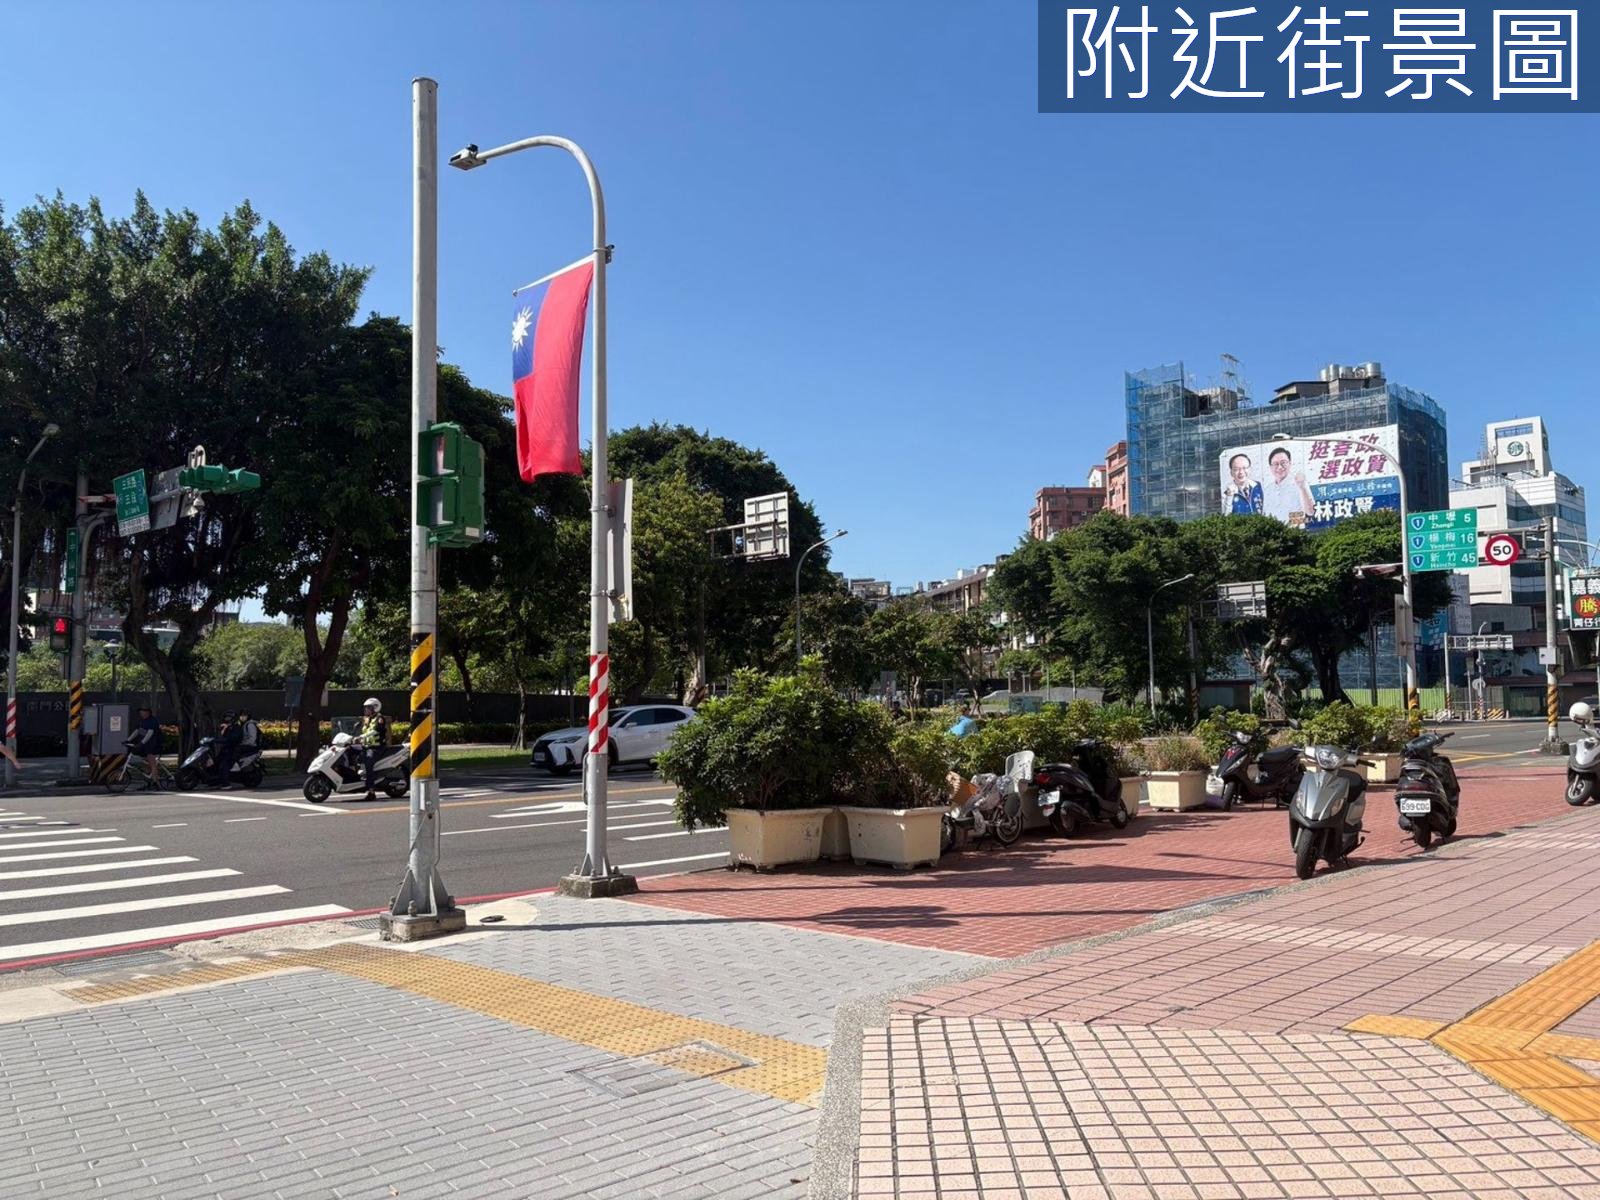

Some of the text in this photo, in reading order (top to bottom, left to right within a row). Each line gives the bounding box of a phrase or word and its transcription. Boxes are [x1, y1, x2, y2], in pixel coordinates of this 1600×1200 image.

[1318, 454, 1388, 480] 選政賢
[1314, 495, 1374, 522] 林政賢
[1428, 511, 1456, 522] 中壢
[1464, 513, 1471, 523] 5
[1460, 533, 1474, 544] 16
[1493, 545, 1512, 556] 50
[1430, 551, 1456, 562] 新竹
[1461, 553, 1476, 563] 45
